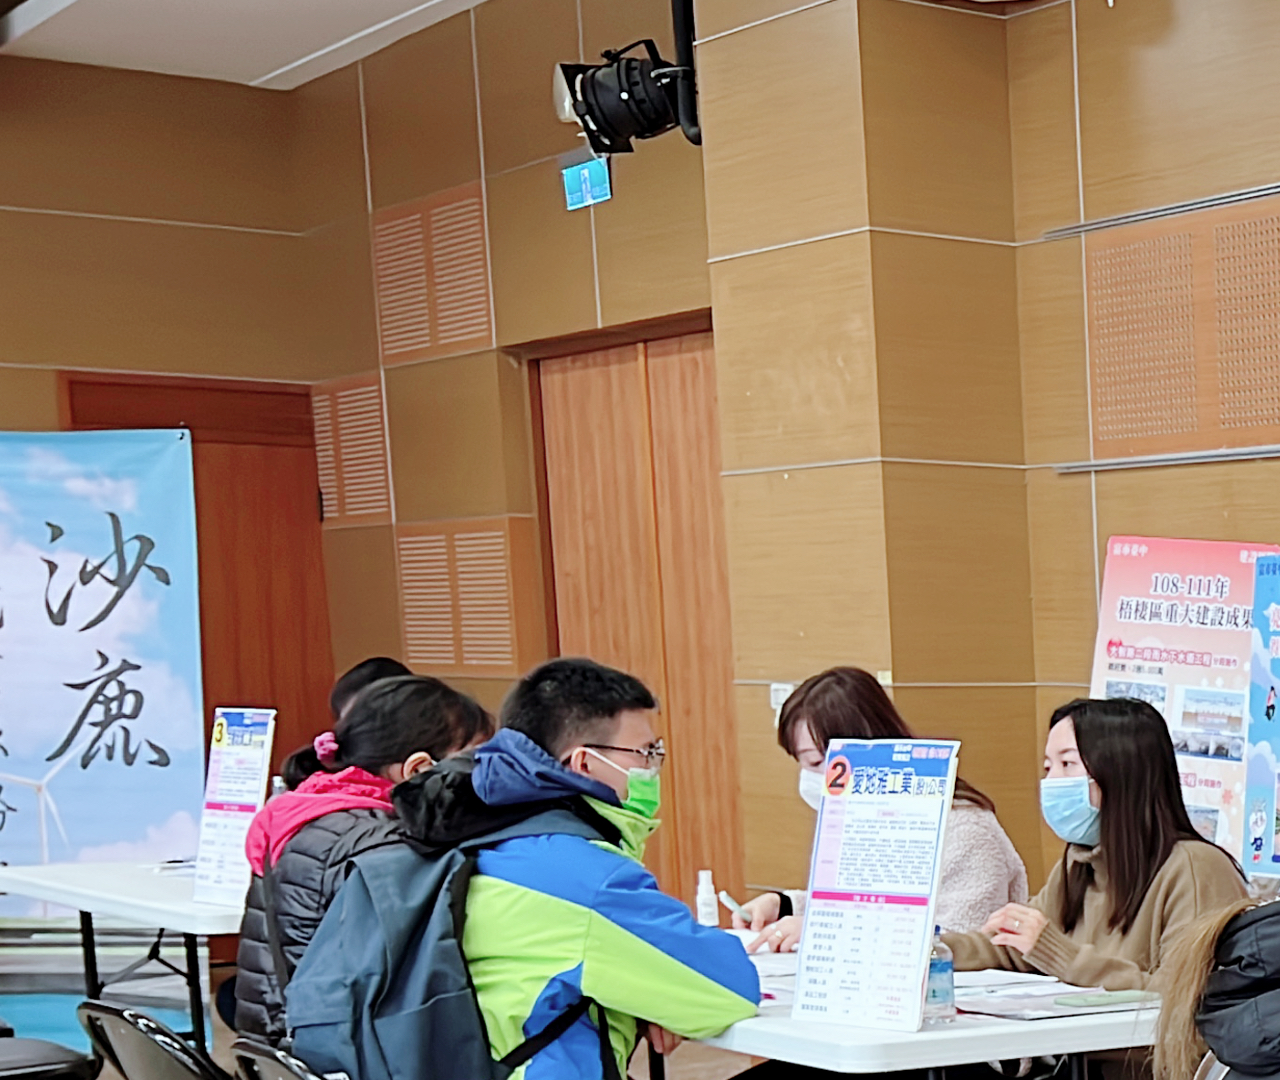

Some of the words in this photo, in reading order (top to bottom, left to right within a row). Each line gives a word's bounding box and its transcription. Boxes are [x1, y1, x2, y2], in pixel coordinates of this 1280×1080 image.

[1152, 575, 1228, 599] 108-111年
[1118, 599, 1254, 629] 梧棲區重大建設成果
[42, 512, 170, 770] 沙鹿
[215, 723, 224, 742] 3
[829, 762, 847, 788] 2
